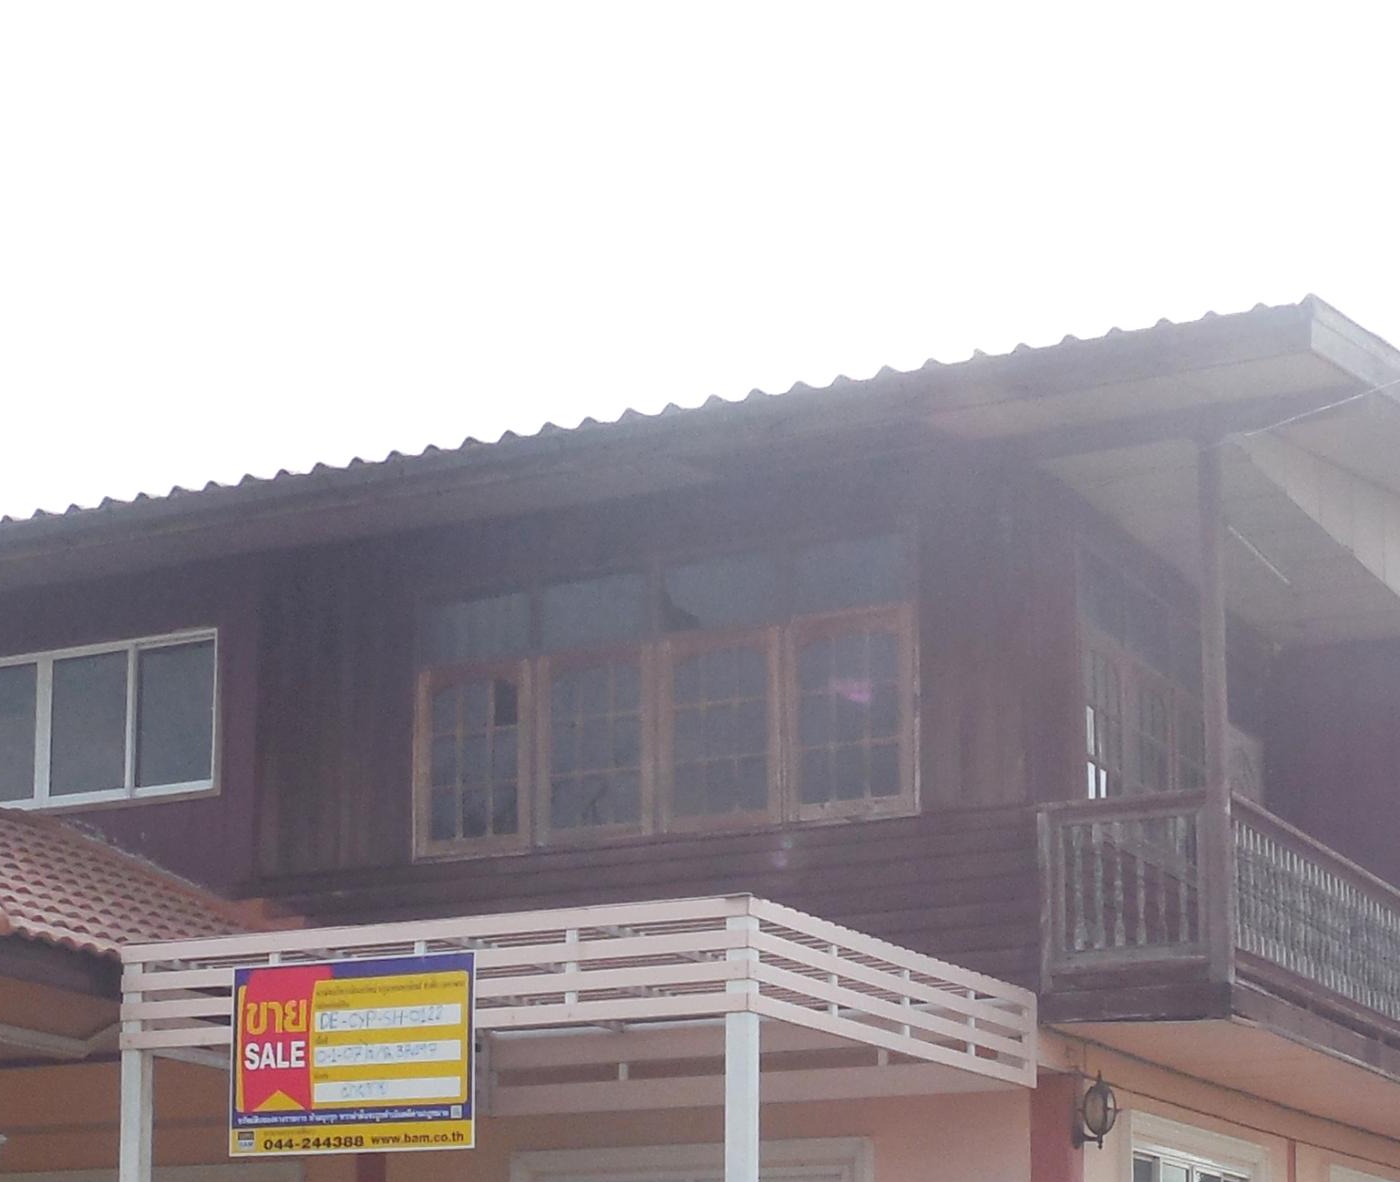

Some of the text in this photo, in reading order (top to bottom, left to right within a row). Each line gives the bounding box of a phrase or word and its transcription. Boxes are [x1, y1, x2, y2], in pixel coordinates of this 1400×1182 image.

[246, 999, 307, 1035] ขาย
[244, 1040, 305, 1070] SALE
[264, 1135, 364, 1150] 044-244388
[371, 1131, 464, 1145] www.bam.co.th
